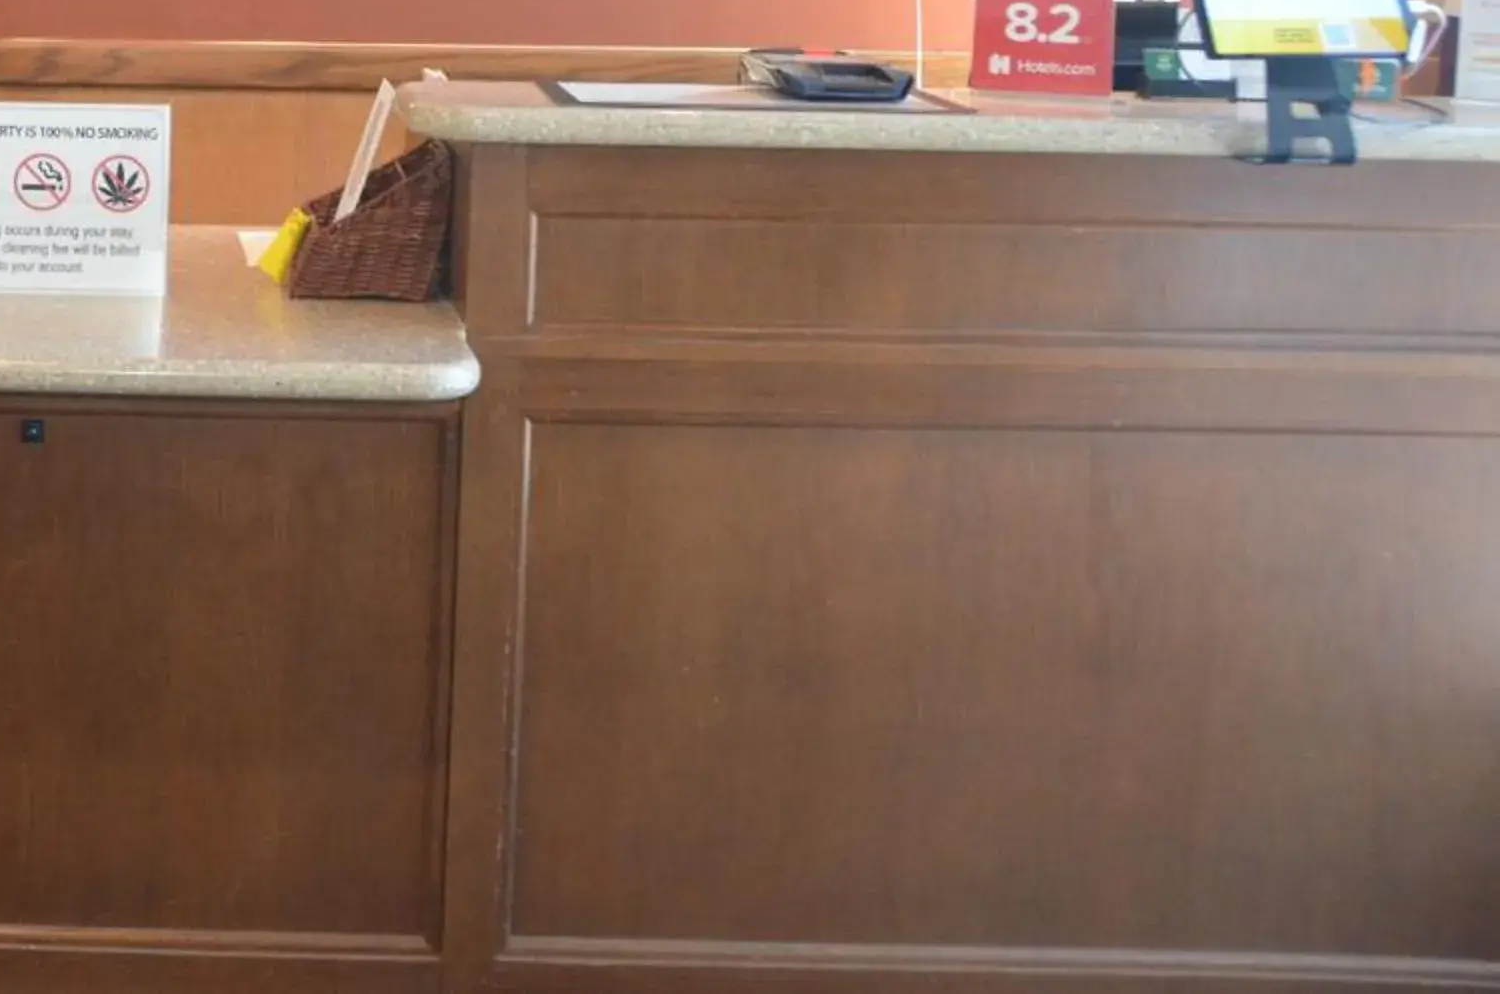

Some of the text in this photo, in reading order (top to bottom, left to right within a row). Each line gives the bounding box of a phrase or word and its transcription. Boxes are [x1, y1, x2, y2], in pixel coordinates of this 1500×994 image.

[1004, 2, 1081, 44] 8.2
[1016, 58, 1097, 76] Hotels.com
[25, 126, 37, 139] IS
[40, 125, 73, 139] 100%
[75, 126, 94, 140] NO
[97, 127, 158, 141] SMOKING
[4, 225, 41, 236] occurs
[43, 224, 79, 239] during
[82, 226, 107, 240] your
[2, 242, 49, 257] cleaning
[51, 243, 69, 255] fee
[73, 243, 90, 255] will
[92, 244, 107, 256] be
[109, 243, 140, 256] billed
[11, 261, 35, 274] your
